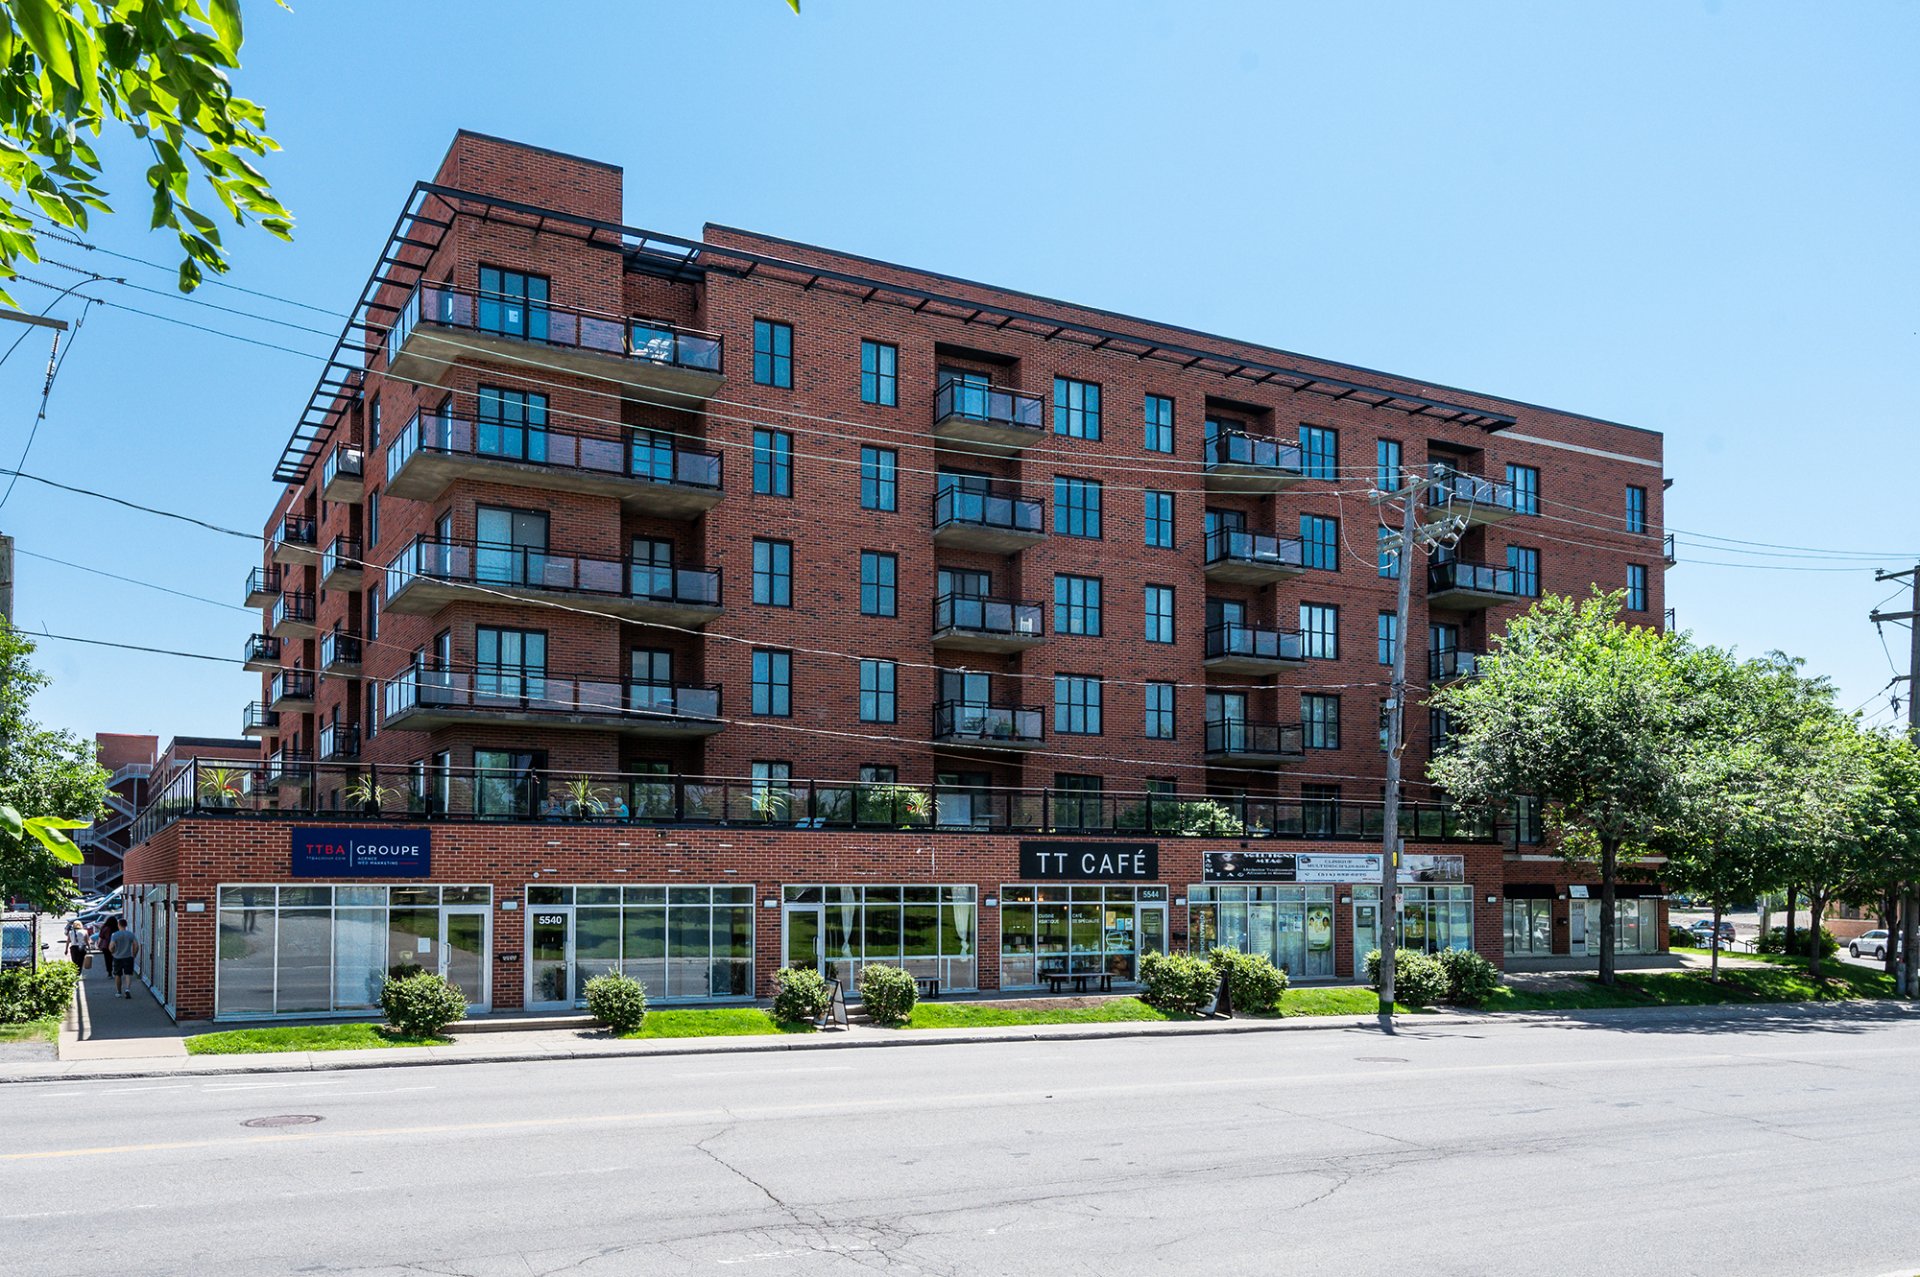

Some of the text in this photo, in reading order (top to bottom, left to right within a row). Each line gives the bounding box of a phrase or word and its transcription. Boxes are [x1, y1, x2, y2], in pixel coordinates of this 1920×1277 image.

[306, 844, 345, 855] TTBA
[356, 845, 419, 856] GROUPE
[1036, 849, 1146, 874] TT CAFÉ
[1143, 890, 1159, 898] 5544
[538, 915, 562, 924] 5540
